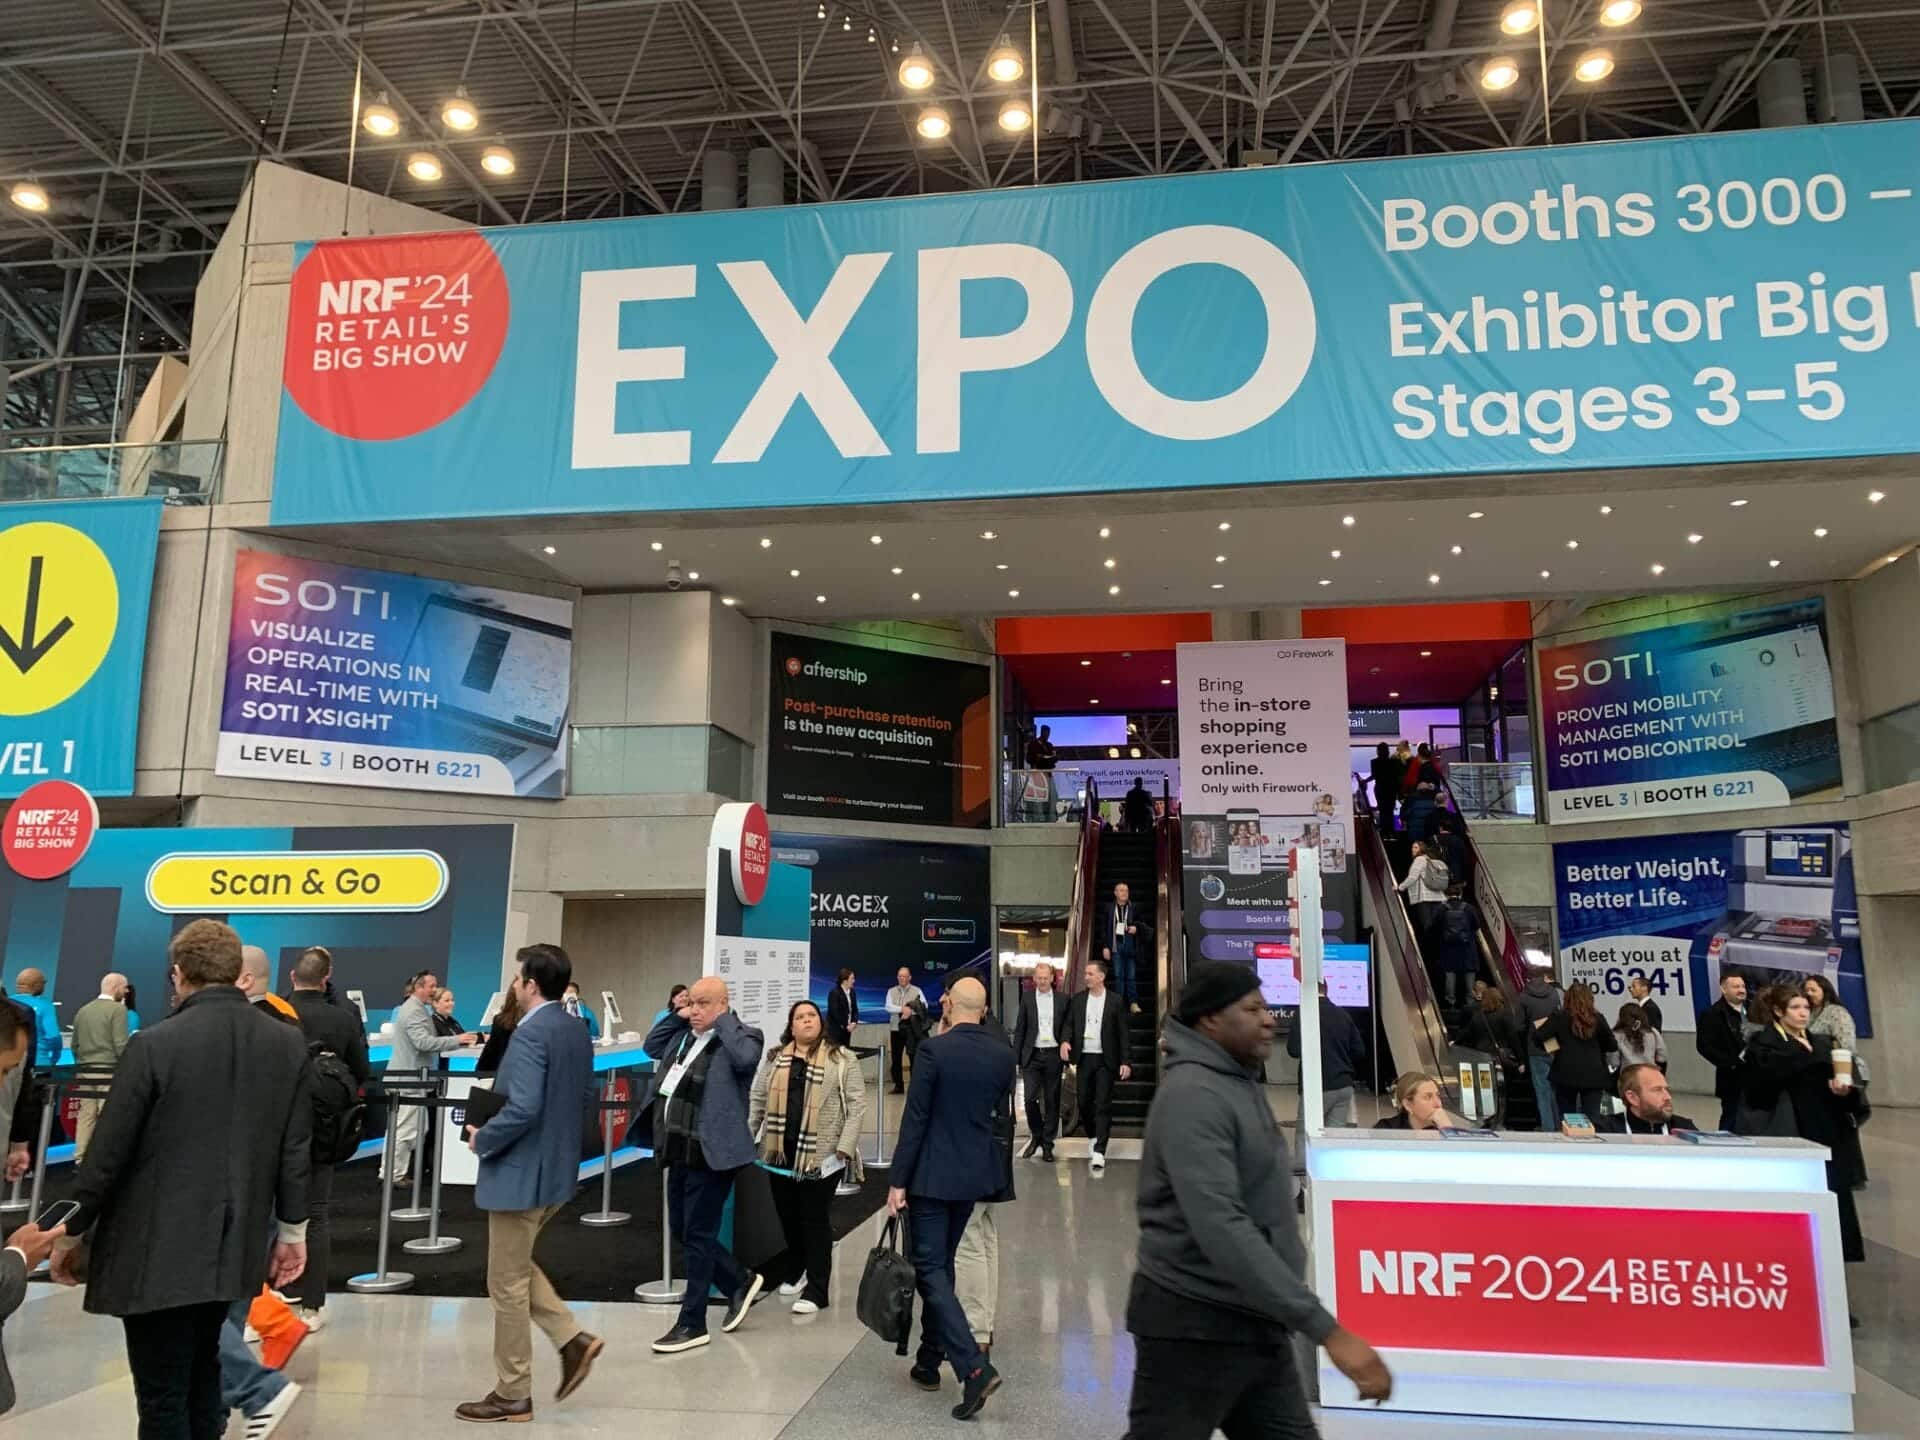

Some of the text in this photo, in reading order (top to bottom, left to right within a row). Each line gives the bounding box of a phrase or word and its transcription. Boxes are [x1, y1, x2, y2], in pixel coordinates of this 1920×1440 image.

[1383, 183, 1655, 252] Booths
[1676, 173, 1846, 233] 3000
[318, 277, 410, 316] NRF
[315, 313, 470, 343] RETAIL'S
[1389, 285, 1734, 356] Exhibitor
[1756, 271, 1889, 352] Big
[313, 341, 468, 371] BIG SHOW
[571, 225, 1317, 469] EXPO
[1393, 383, 1673, 453] Stages
[254, 573, 390, 620] SOTI
[249, 619, 376, 651] VISUALIZE
[247, 646, 431, 683] OPERATIONS IN
[1292, 650, 1334, 659] Firework
[803, 661, 868, 685] aftership
[1554, 651, 1654, 691] SOTI
[244, 673, 439, 709] REAL-TIME WITH
[1199, 677, 1243, 695] Bring
[241, 700, 393, 731] SOTI XSIGHT
[784, 698, 952, 731] Post-purchase retention
[1200, 697, 1311, 712] the in-store
[1557, 688, 1723, 725] PROVEN MOBILITY
[784, 716, 933, 747] is the new acquisition
[1200, 718, 1286, 736] shopping
[1559, 708, 1744, 747] MANAGEMENT WITH
[63, 740, 75, 774] 1
[240, 745, 481, 779] LEVEL 3 BOOTH 6221
[1201, 739, 1308, 757] experience
[1559, 733, 1746, 768] SOTI MOBICONTROL
[1201, 761, 1264, 776] online.
[1201, 781, 1322, 796] Only with Firework.
[1564, 780, 1754, 810] LEVEL 3 BOOTH 6221
[16, 826, 78, 837] RETAIL'S
[18, 809, 55, 825] NRF
[14, 838, 75, 849] BIG SHOW
[210, 868, 381, 895] Scan & Go
[1567, 857, 1727, 883] Better Weight,
[1226, 898, 1250, 906] Meet
[1252, 898, 1271, 906] with
[1569, 887, 1687, 909] Better Life.
[817, 919, 827, 927] at
[828, 918, 842, 927] the
[843, 918, 869, 929] Speed
[870, 918, 881, 928] of
[881, 919, 889, 928] AI
[1246, 915, 1273, 924] Booth
[1226, 940, 1240, 948] The
[1572, 947, 1682, 966] Meet you at
[1572, 967, 1596, 976] Level
[1359, 1249, 1623, 1303] NRF 2024
[1629, 1259, 1788, 1286] RETAIL'S
[1630, 1283, 1788, 1311] BIG SHOW
